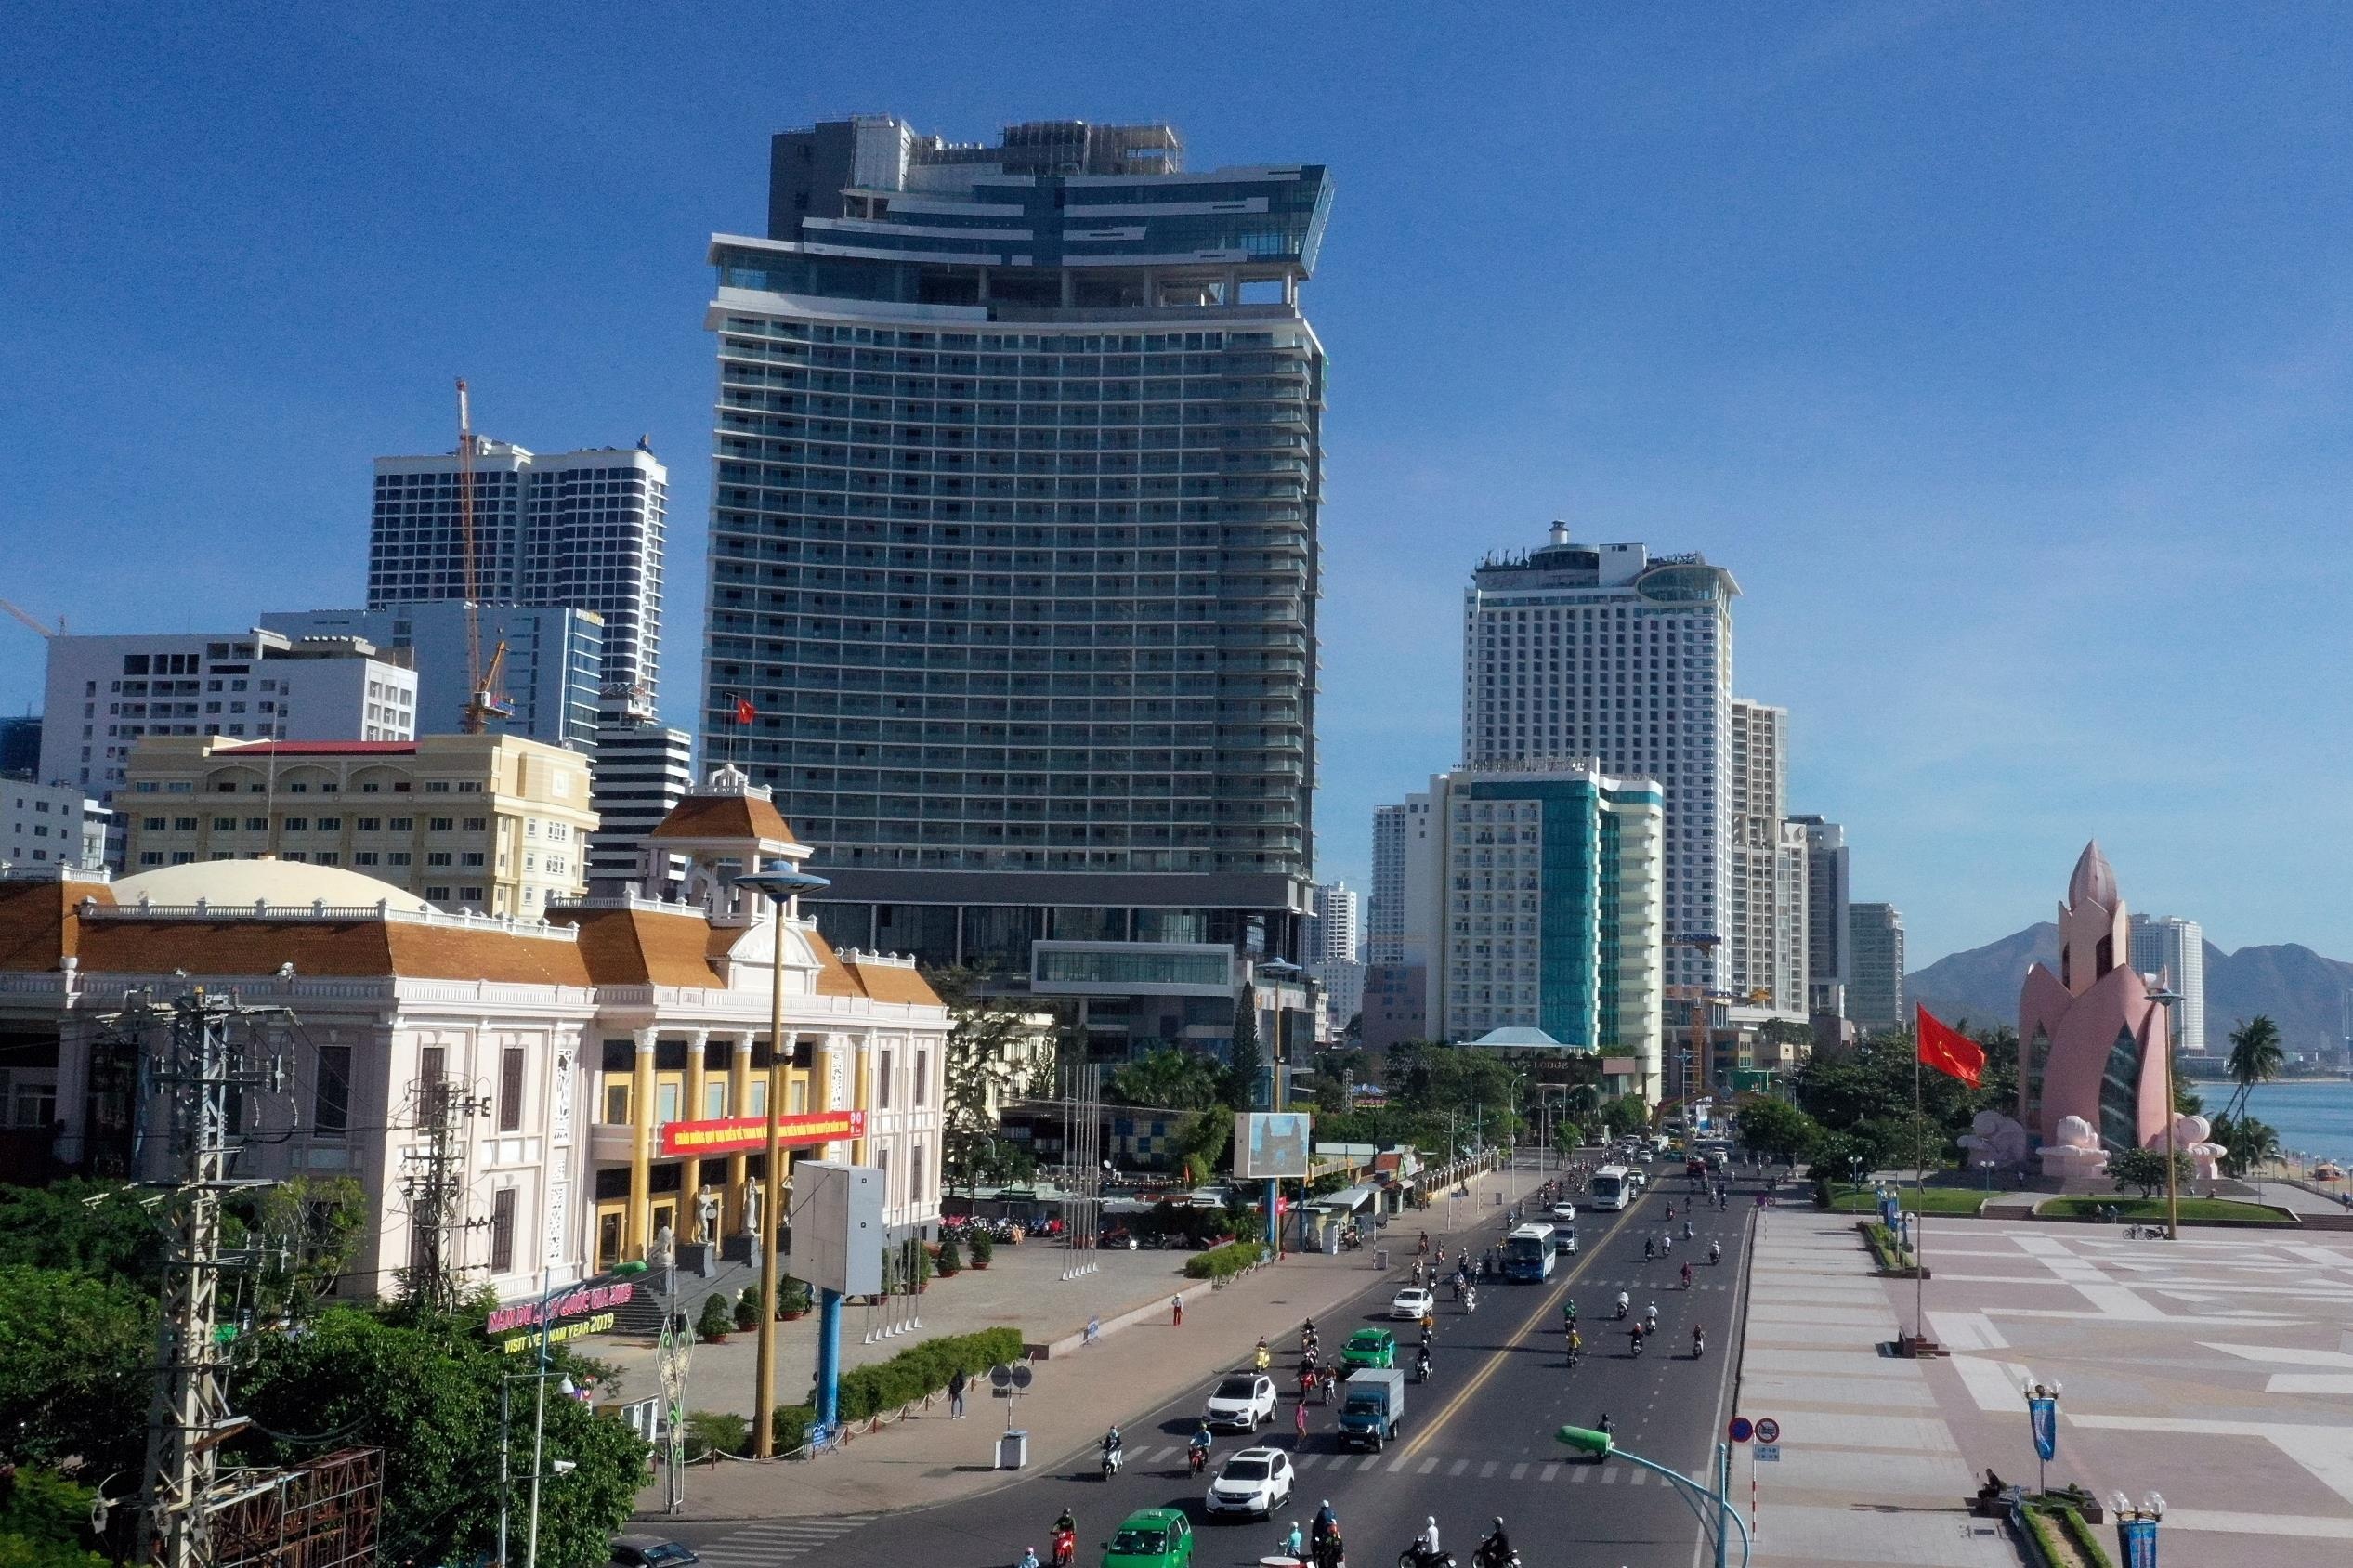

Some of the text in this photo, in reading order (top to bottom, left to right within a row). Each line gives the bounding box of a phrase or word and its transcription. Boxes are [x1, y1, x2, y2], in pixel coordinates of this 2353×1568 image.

[516, 1304, 533, 1326] DU
[592, 1287, 608, 1310] GIA
[609, 1283, 634, 1306] 2019
[504, 1336, 527, 1353] VISIT
[548, 1327, 567, 1343] NAM
[569, 1321, 589, 1338] YEAR
[590, 1312, 614, 1333] 2019
